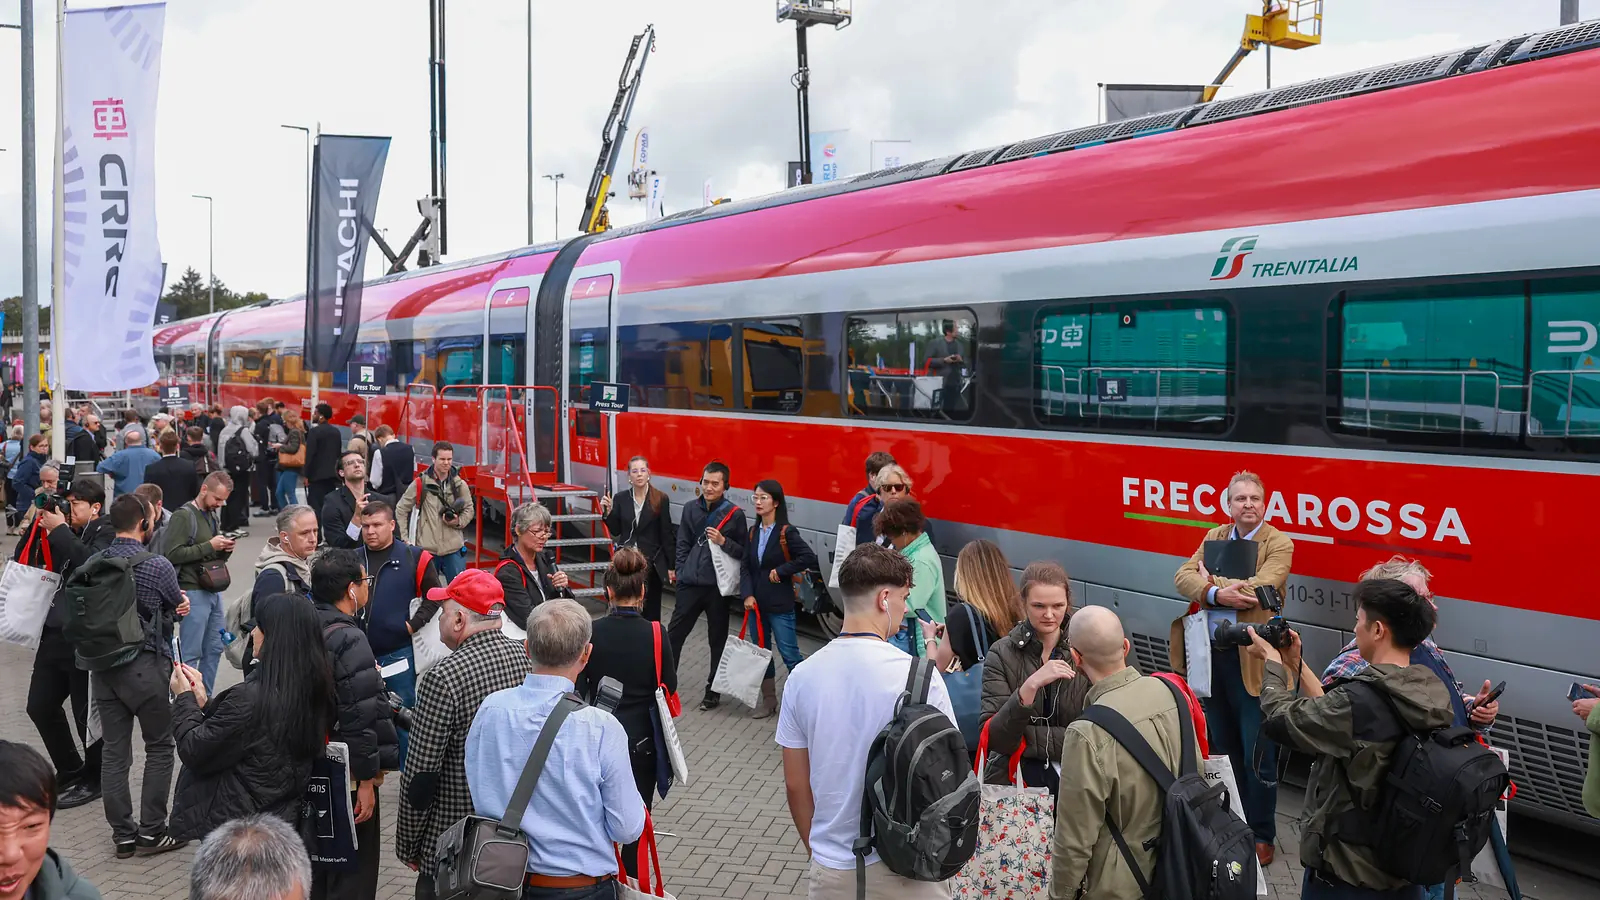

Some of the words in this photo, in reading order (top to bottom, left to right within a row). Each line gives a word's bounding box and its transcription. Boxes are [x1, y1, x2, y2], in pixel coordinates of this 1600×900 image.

[1252, 256, 1359, 278] TRENITALIA
[353, 383, 368, 391] Press
[595, 400, 610, 408] Press
[1122, 476, 1471, 545] FRECAROSSA
